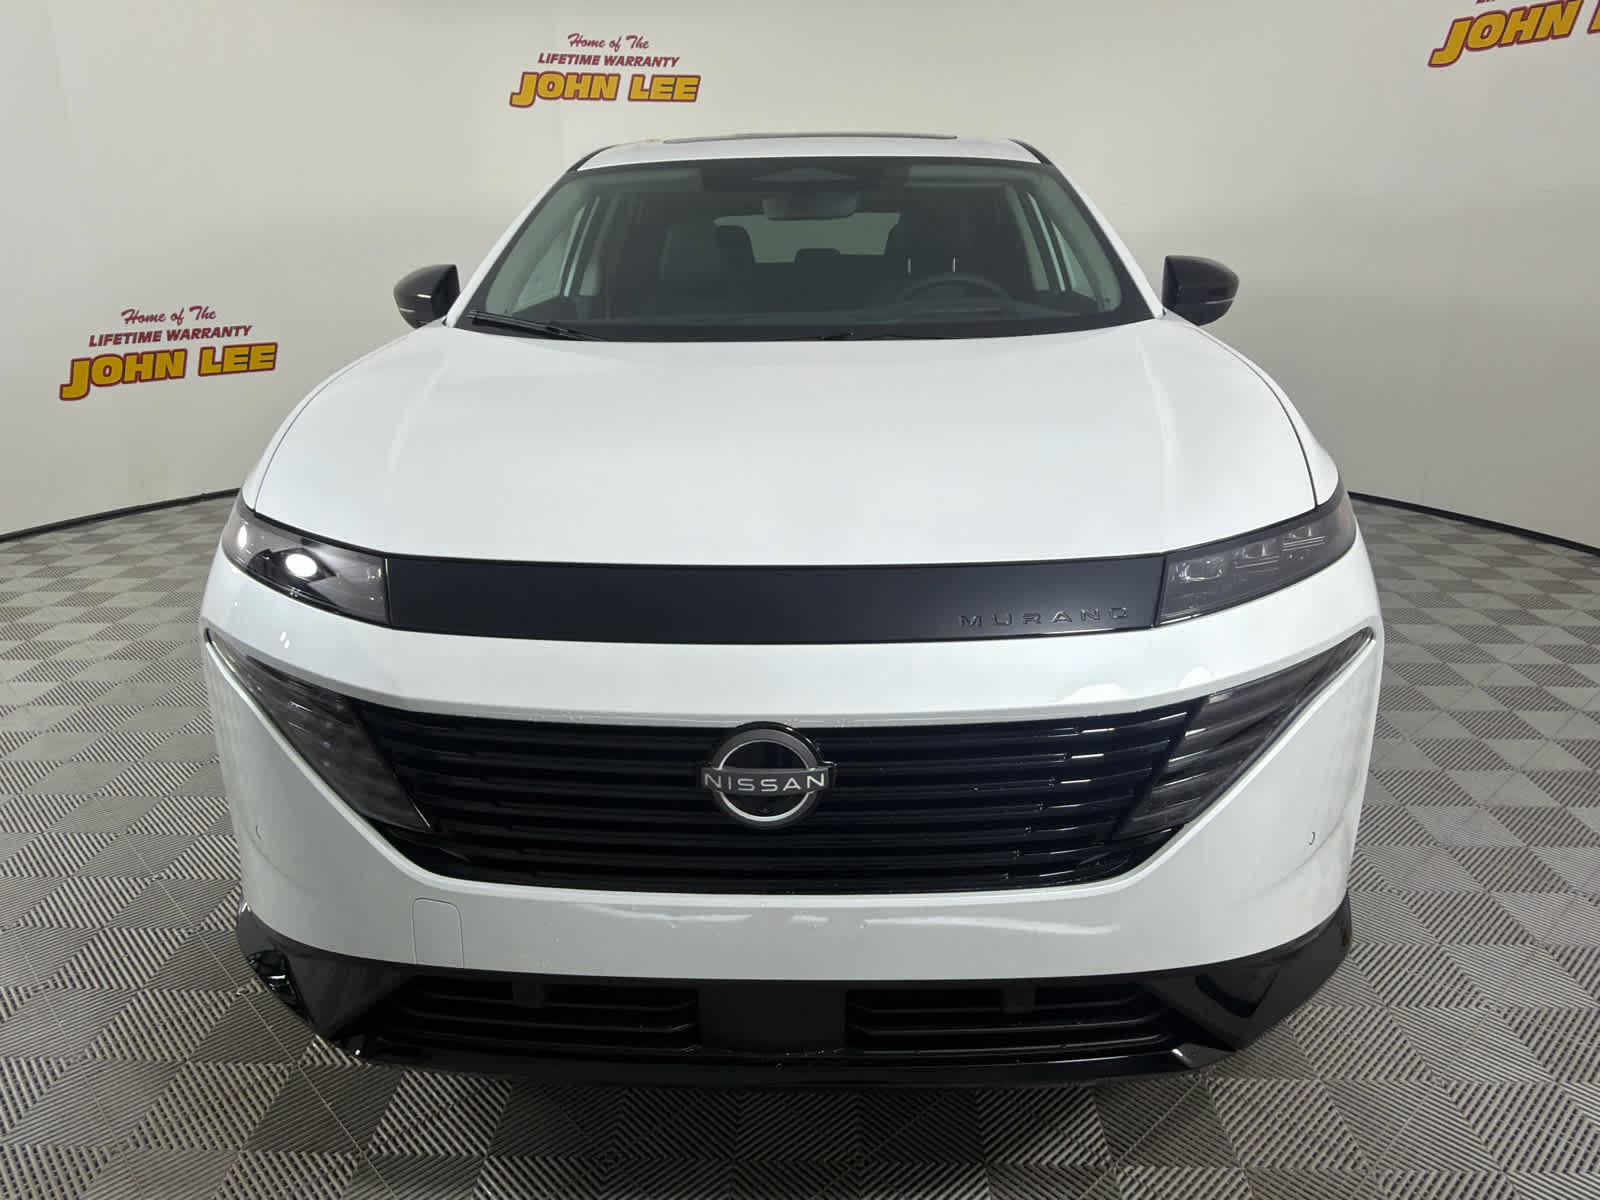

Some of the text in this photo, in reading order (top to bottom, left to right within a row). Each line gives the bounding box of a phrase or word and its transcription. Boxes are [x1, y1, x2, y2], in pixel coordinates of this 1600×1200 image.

[568, 33, 650, 52] Home of The
[1428, 0, 1583, 67] JOHN
[538, 53, 680, 67] LIFETIME WARRANTY
[509, 71, 701, 108] JOHN LEE
[121, 305, 217, 325] Home of The
[89, 325, 252, 347] LIFETIME WARRANTY
[59, 342, 278, 401] JOHN LEE
[704, 772, 825, 792] NISSAN
